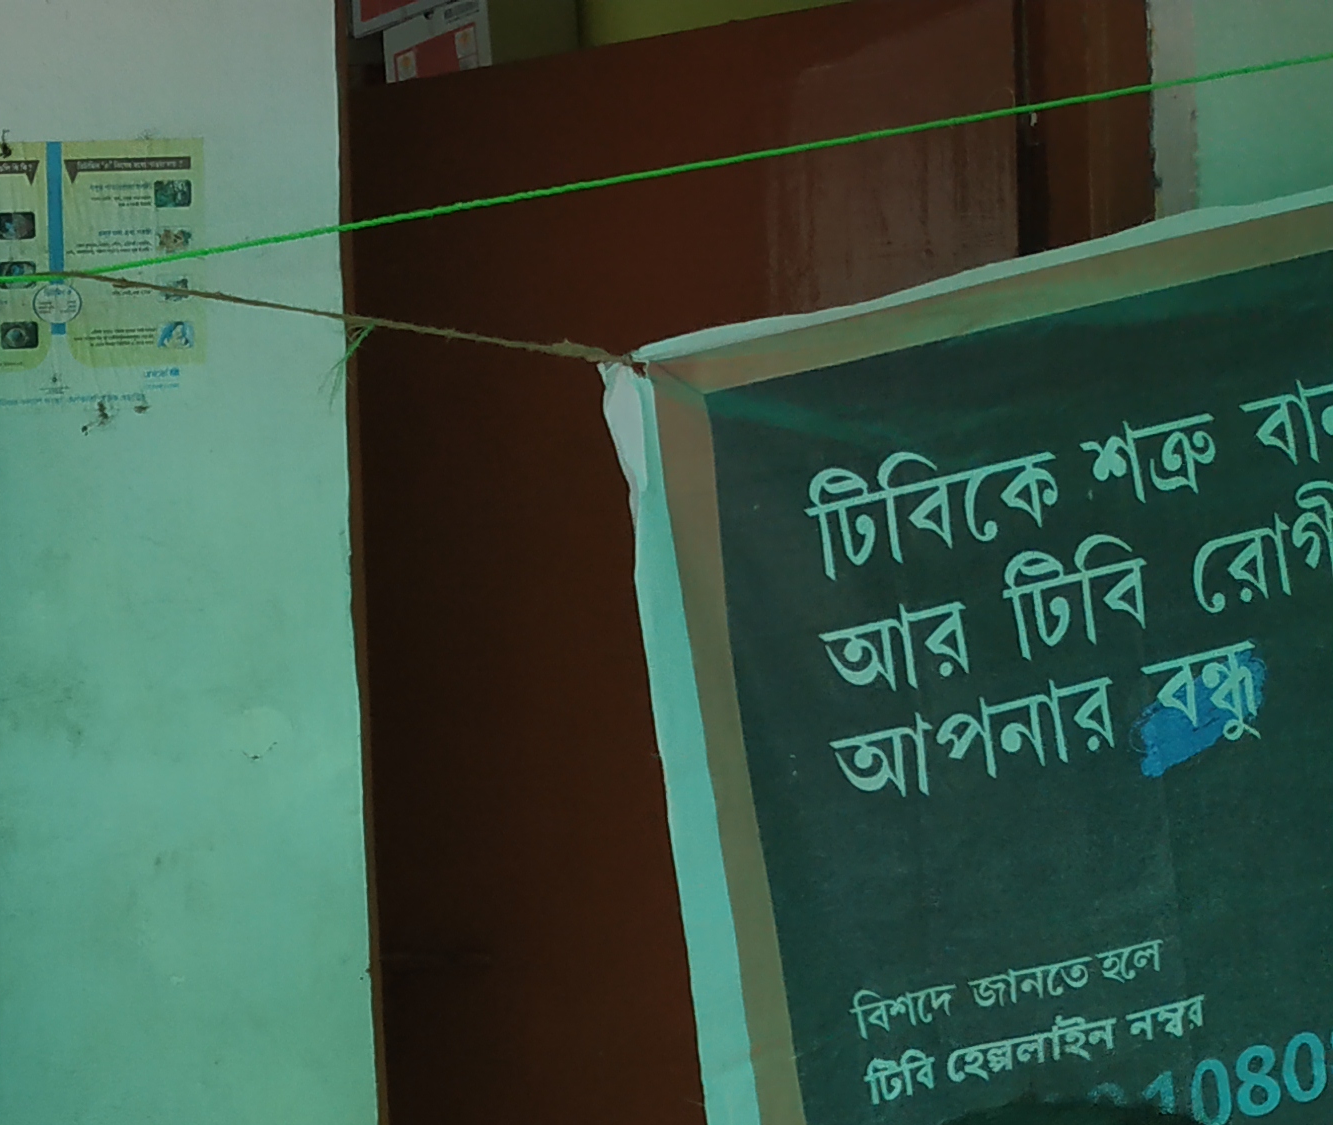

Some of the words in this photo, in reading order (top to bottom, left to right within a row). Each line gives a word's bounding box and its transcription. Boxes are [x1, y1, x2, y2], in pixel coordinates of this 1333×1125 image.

[805, 451, 1057, 581] টিবিকে
[1081, 413, 1215, 503] শত্রু
[819, 601, 969, 691] আর
[1003, 534, 1147, 660] টিবি
[829, 677, 1114, 799] আপনার
[1139, 639, 1261, 741] বন্ধু
[850, 982, 957, 1040] বিশদে
[969, 956, 1092, 1010] জানতে
[1097, 938, 1164, 981] হলে
[864, 1048, 935, 1106] টিবি
[946, 1013, 1117, 1085] হেল্পলাইন
